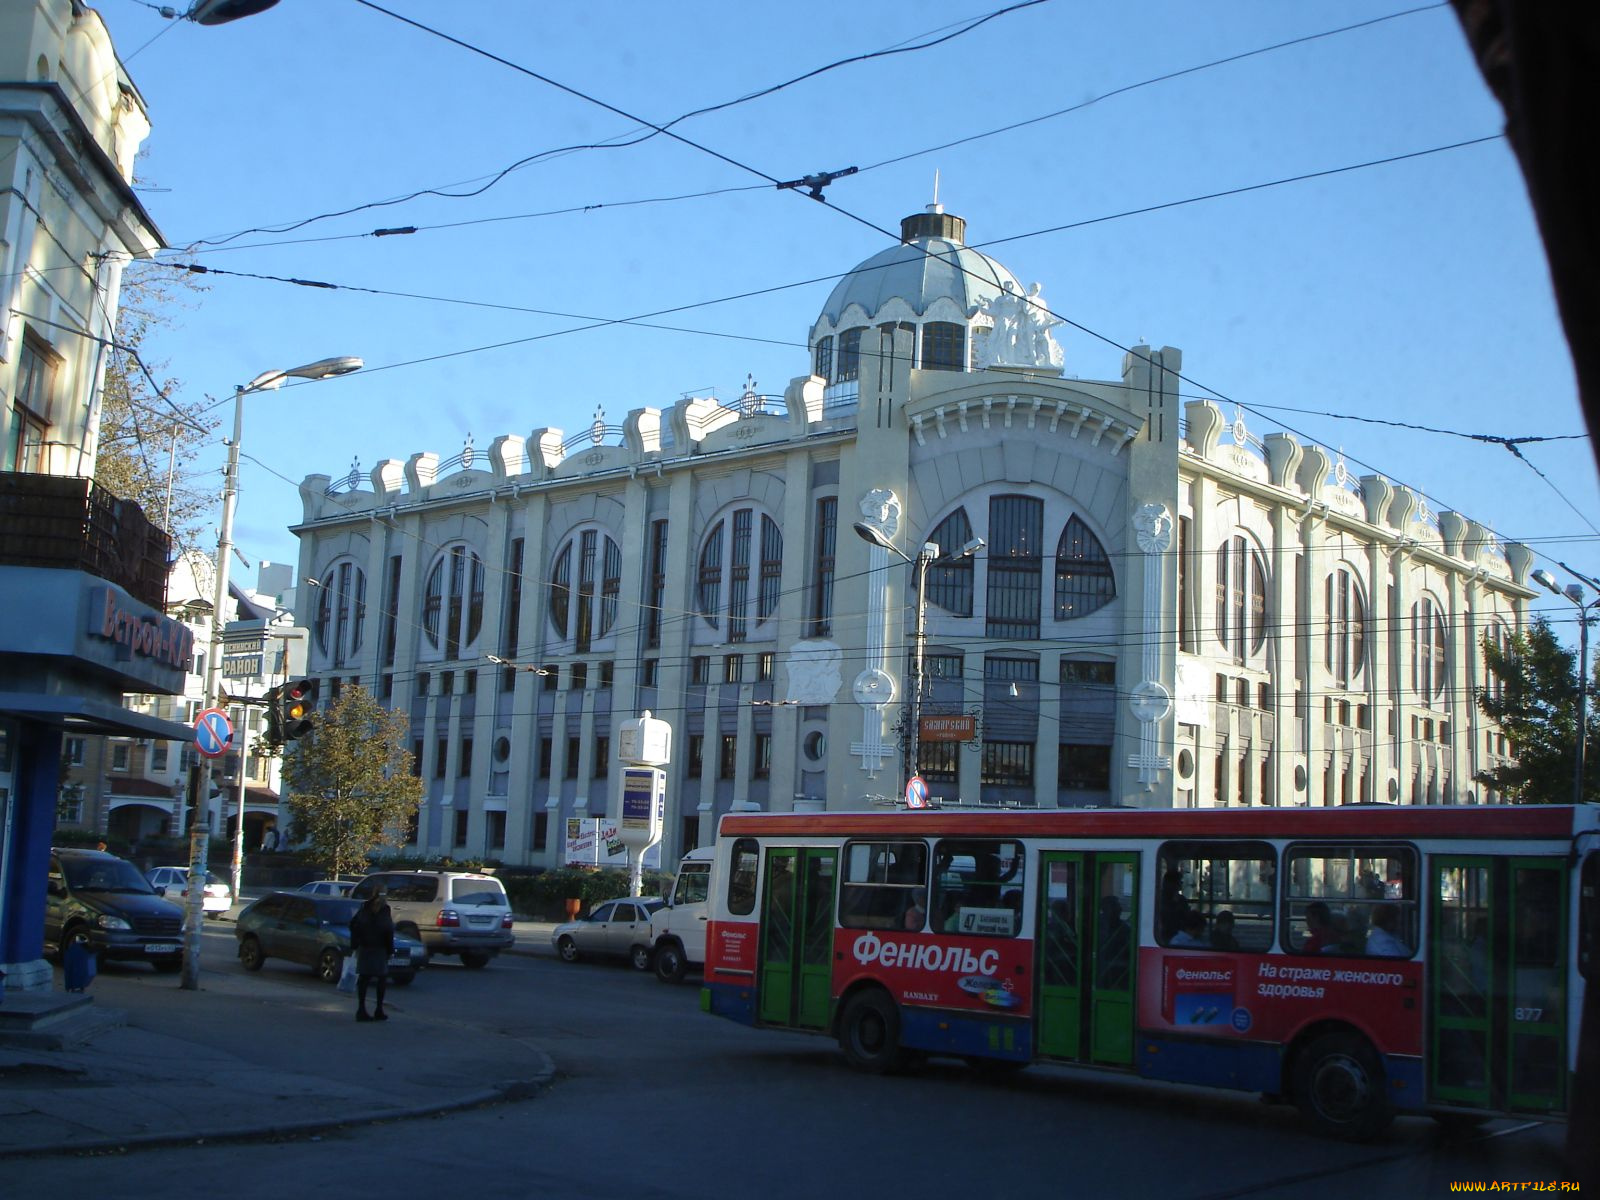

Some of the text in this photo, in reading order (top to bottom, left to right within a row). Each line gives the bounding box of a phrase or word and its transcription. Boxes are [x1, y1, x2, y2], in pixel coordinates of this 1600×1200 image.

[224, 656, 259, 675] РАЙОН
[964, 914, 976, 930] 47
[853, 930, 999, 975] Фенюльс
[1175, 968, 1232, 981] Фенюльс
[1258, 962, 1404, 986] На страже женского
[903, 991, 940, 1001] RANBAXY
[1257, 983, 1325, 998] здоровья
[1514, 1007, 1544, 1021] 877
